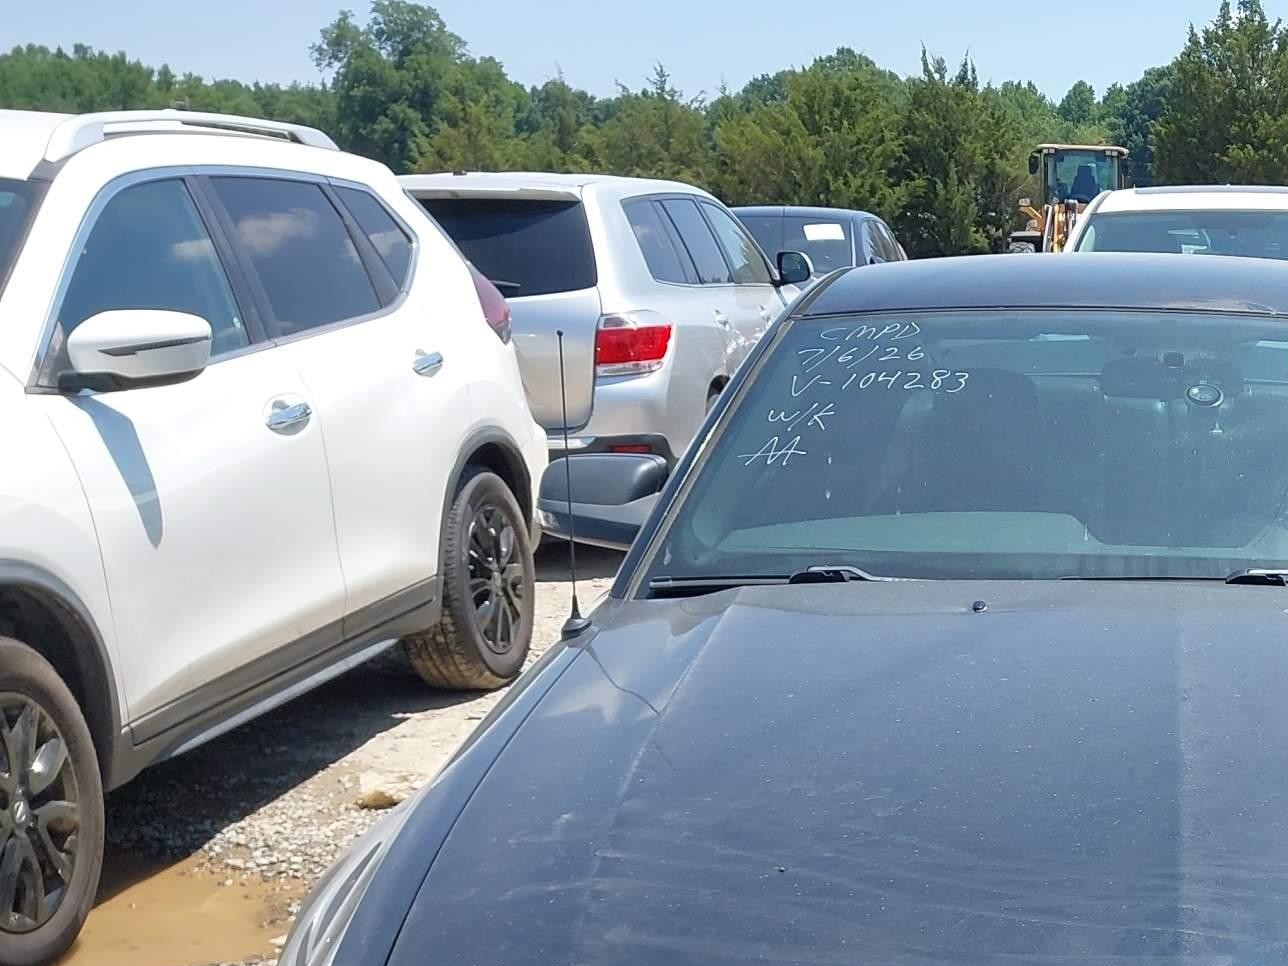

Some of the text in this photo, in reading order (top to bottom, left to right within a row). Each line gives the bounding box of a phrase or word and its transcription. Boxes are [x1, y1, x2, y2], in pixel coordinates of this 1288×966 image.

[820, 321, 921, 341] CMPD
[798, 345, 925, 372] 7/6/26
[791, 370, 969, 397] V-104283
